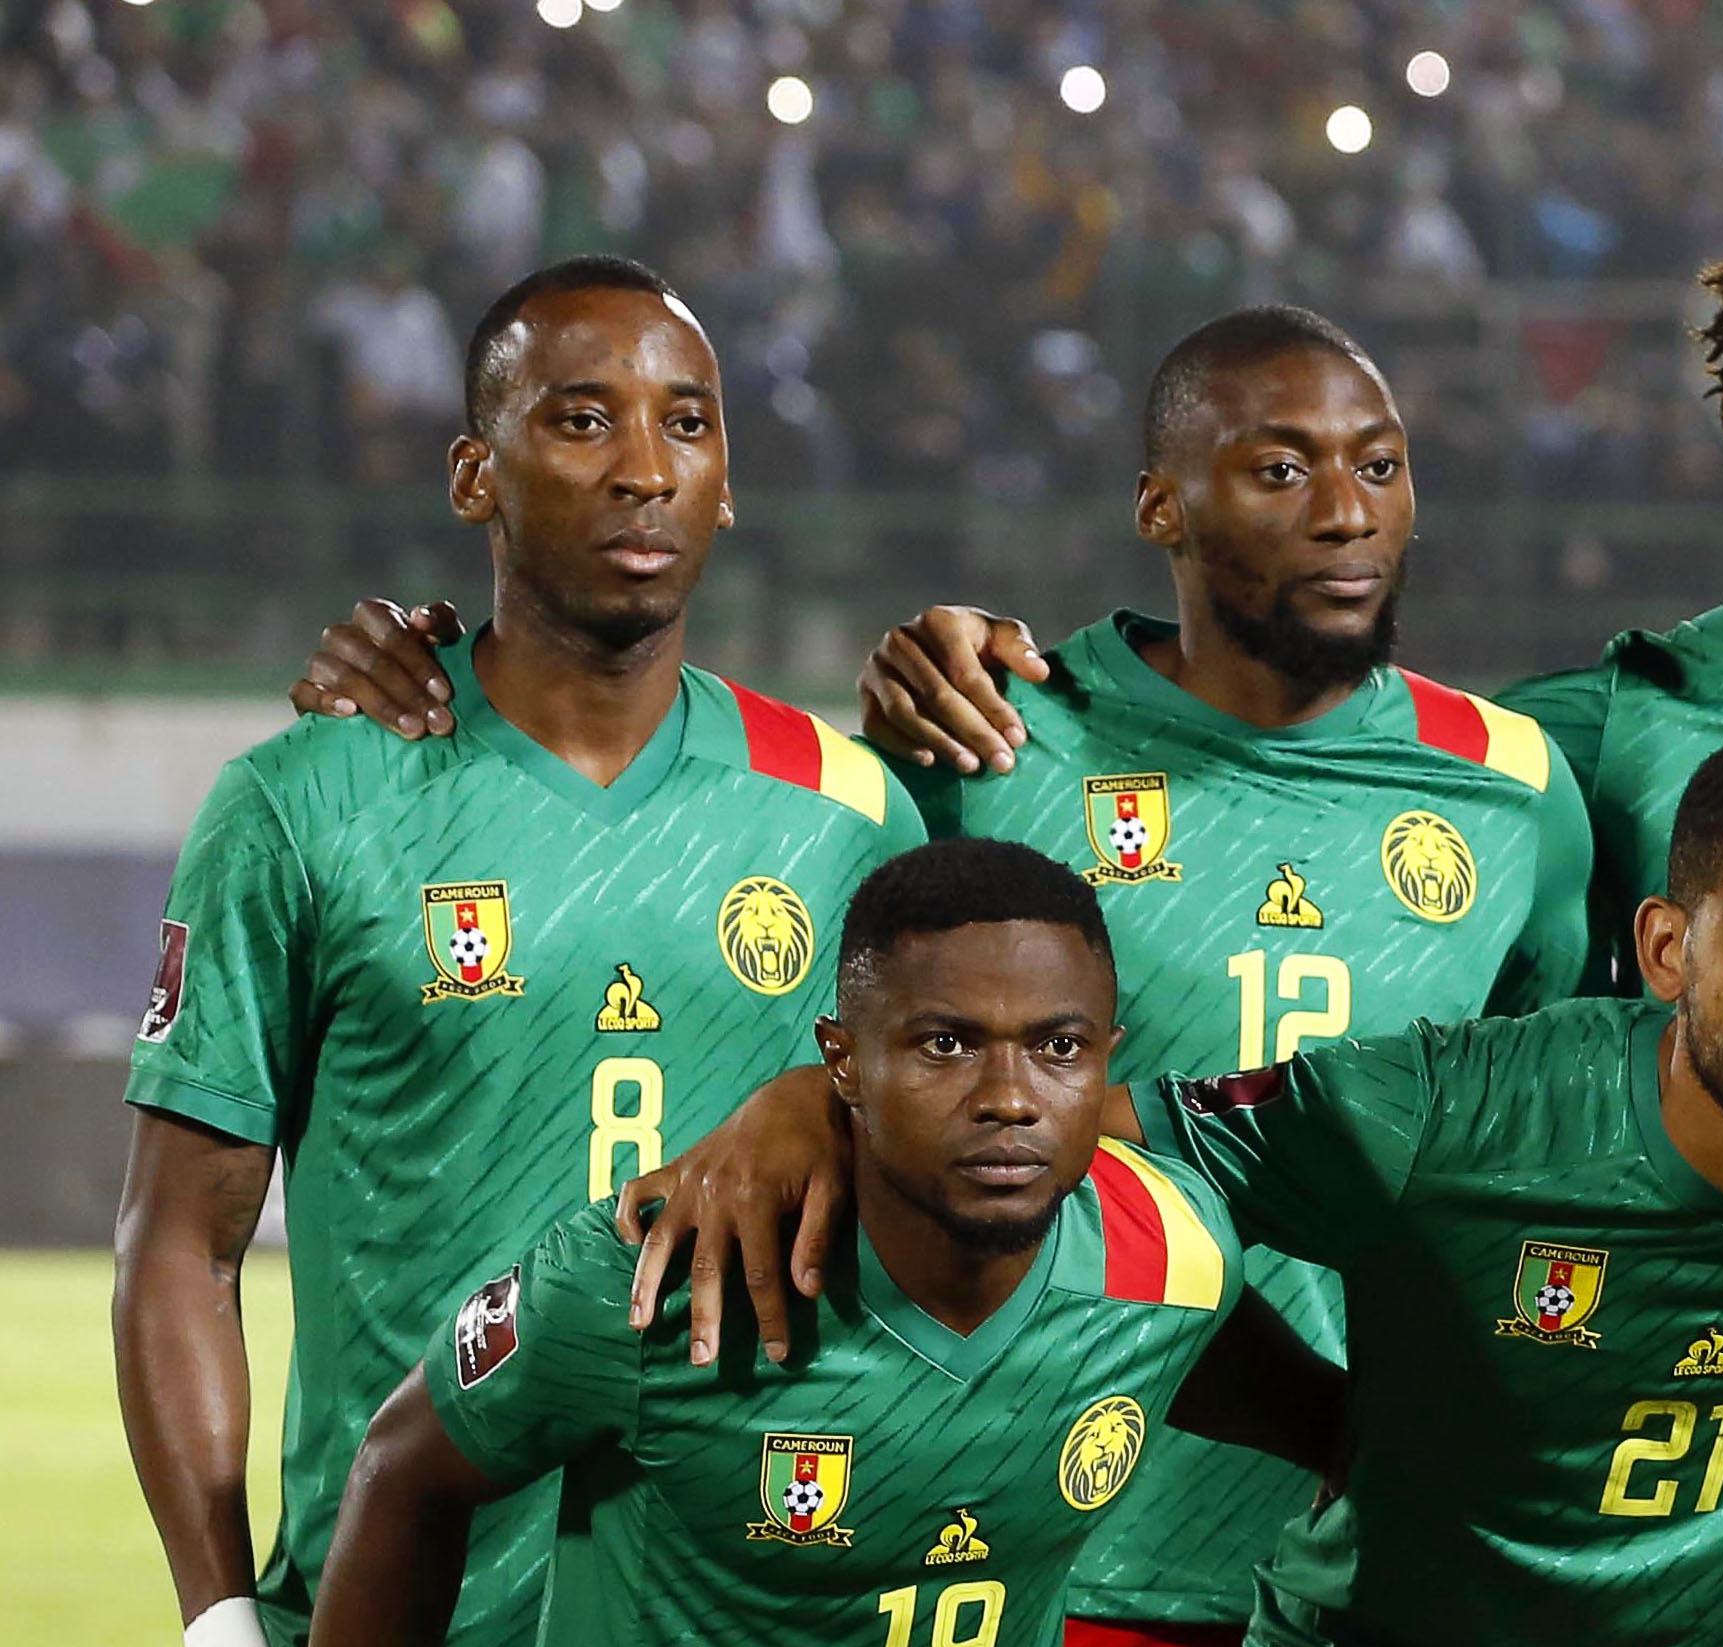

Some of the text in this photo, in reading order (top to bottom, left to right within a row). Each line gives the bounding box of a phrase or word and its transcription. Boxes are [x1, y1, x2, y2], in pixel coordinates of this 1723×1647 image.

[1090, 776, 1160, 794] CAMEROUN
[430, 885, 501, 901] CAMEROUN
[1228, 948, 1352, 1072] 12
[588, 1056, 664, 1205] 8
[1530, 1245, 1601, 1266] CAMEROUN
[773, 1438, 845, 1453] CAMEROUN
